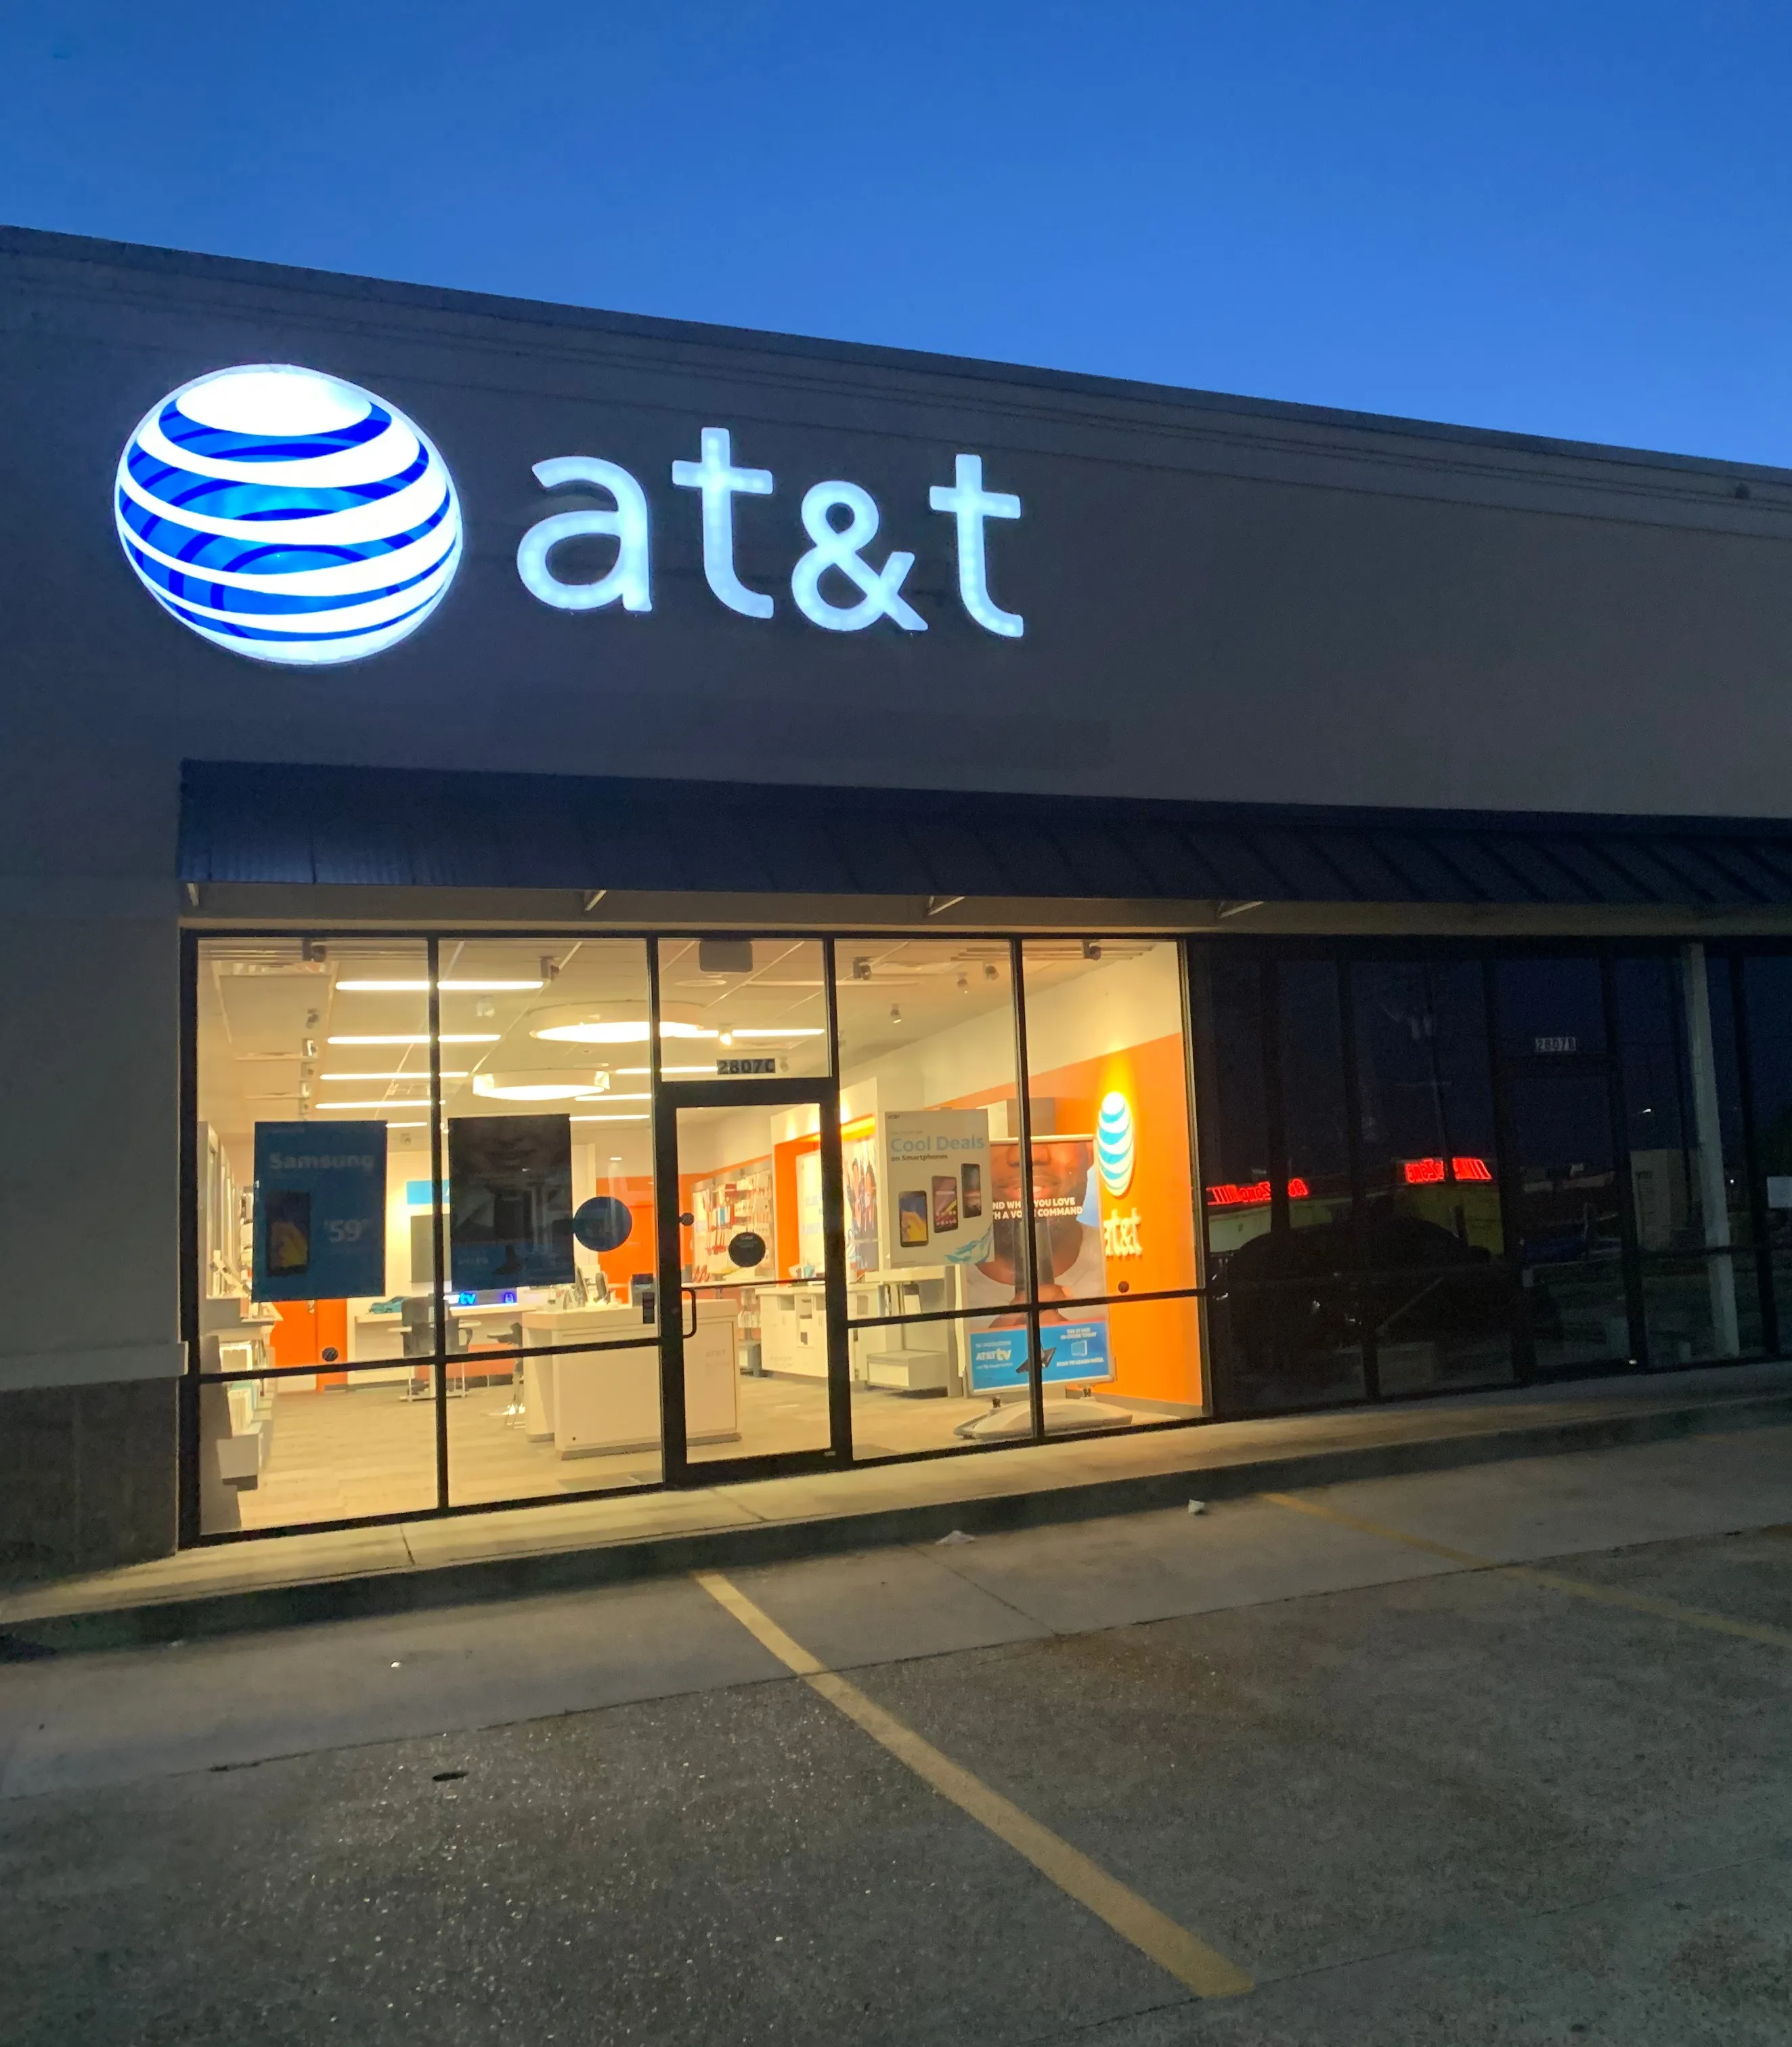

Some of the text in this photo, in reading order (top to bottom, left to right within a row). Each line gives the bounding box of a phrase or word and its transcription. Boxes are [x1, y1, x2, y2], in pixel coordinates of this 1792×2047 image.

[517, 426, 1024, 638] at&t
[717, 1059, 775, 1074] 2807C
[890, 1133, 985, 1152] Cool Deals
[269, 1151, 375, 1173] Samsung
[902, 1153, 948, 1162] Smartphones
[992, 1201, 1005, 1210] ND
[1034, 1198, 1051, 1208] YOU
[1053, 1197, 1075, 1206] LOVE
[1037, 1206, 1083, 1218] COMMAND
